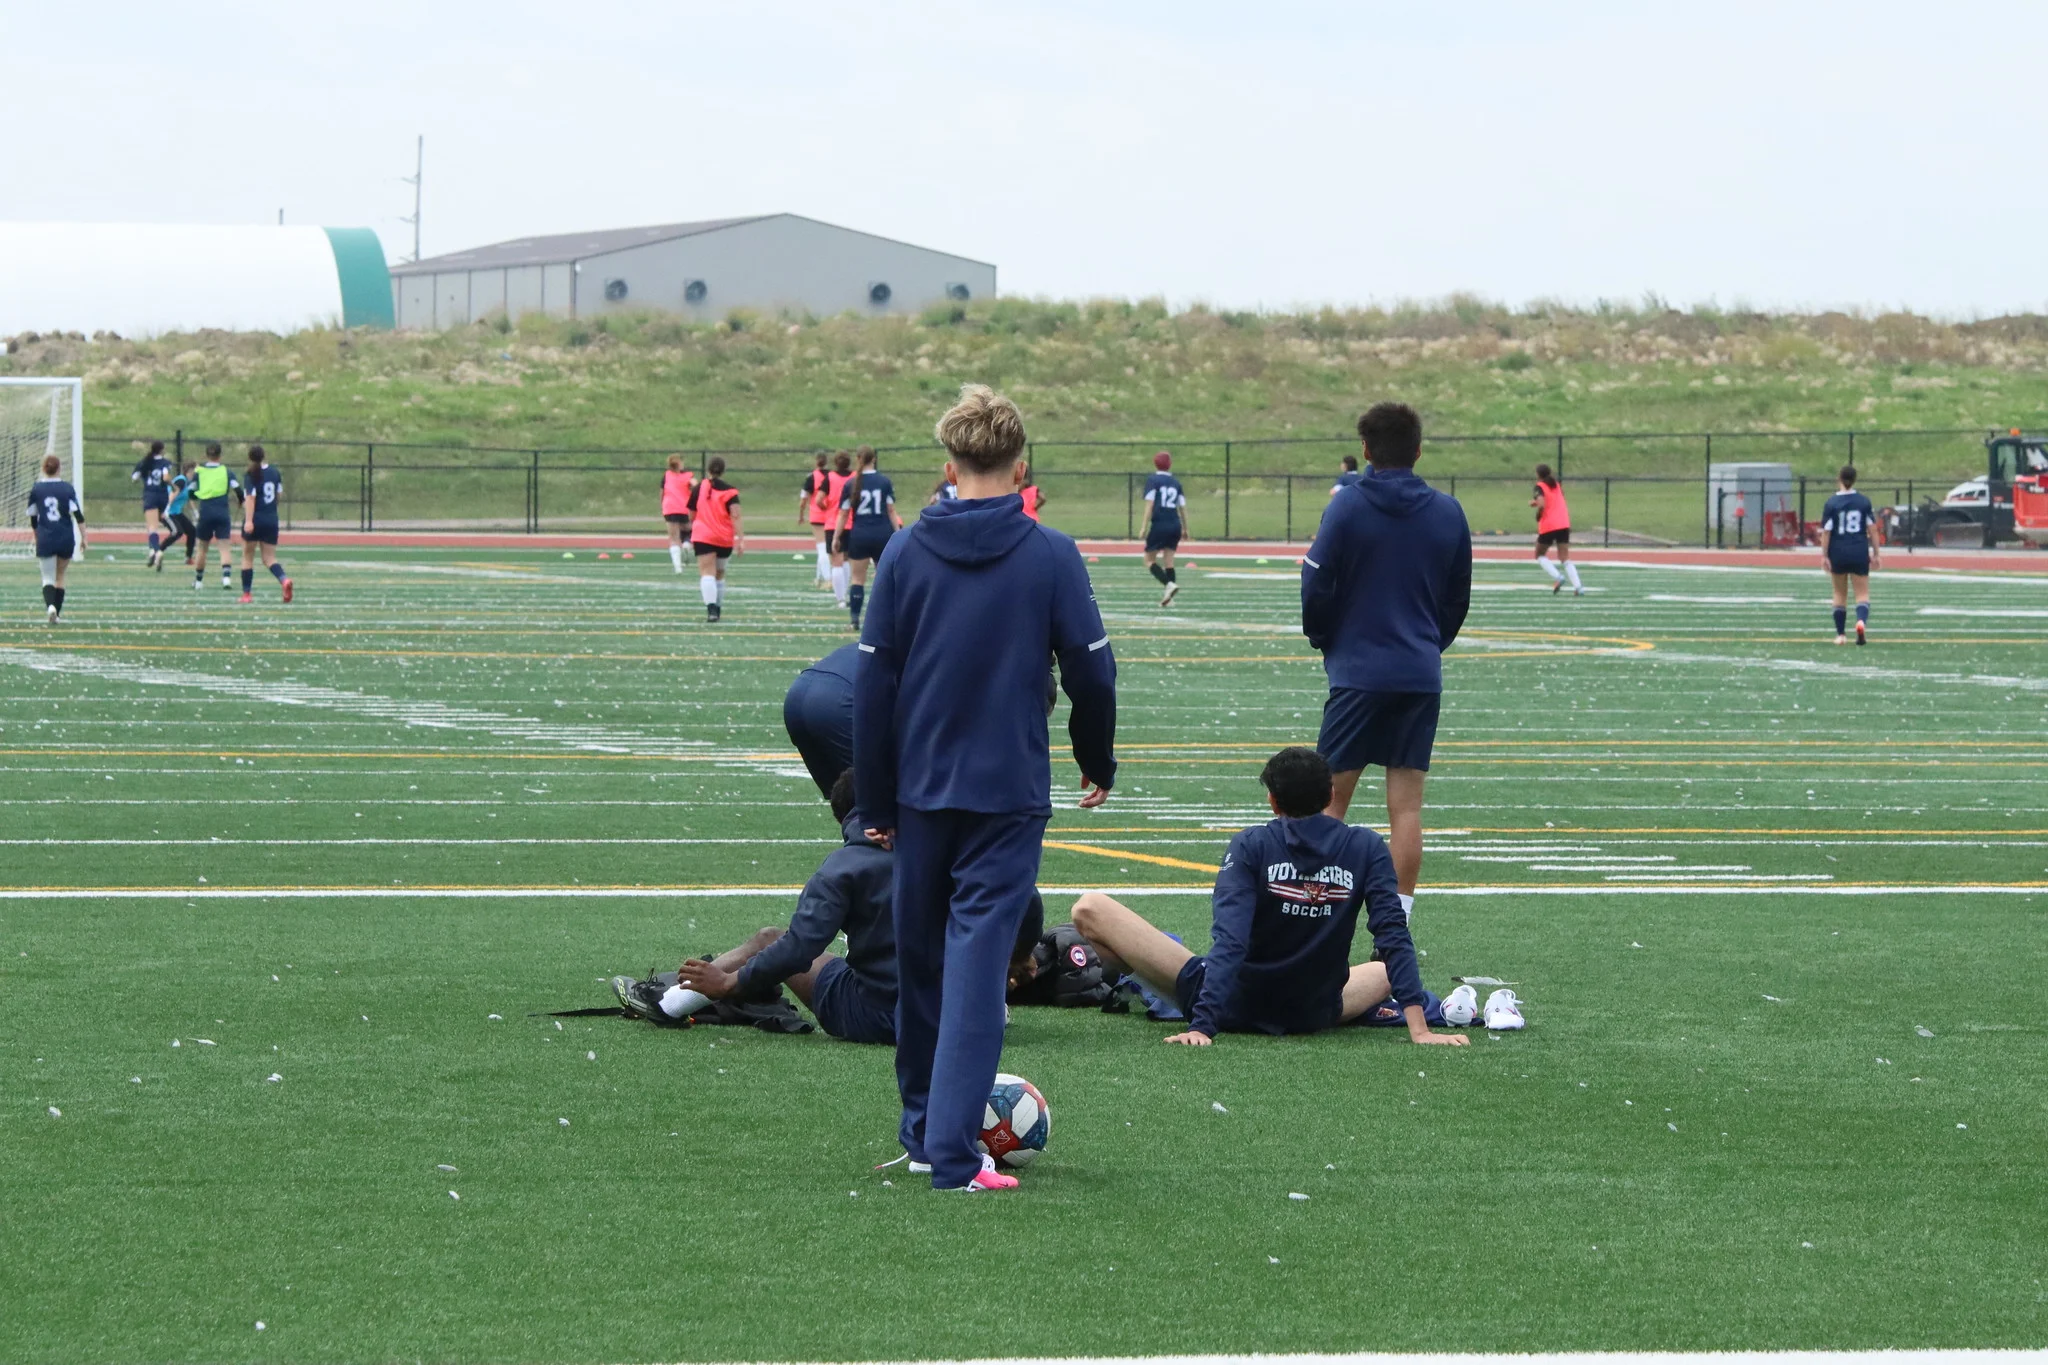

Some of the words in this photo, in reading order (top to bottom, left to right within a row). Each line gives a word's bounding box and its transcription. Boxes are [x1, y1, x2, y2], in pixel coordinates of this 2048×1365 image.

[263, 481, 275, 504] 9
[856, 489, 881, 515] 21
[1159, 486, 1178, 508] 12
[44, 496, 61, 522] 3
[1838, 510, 1861, 535] 18
